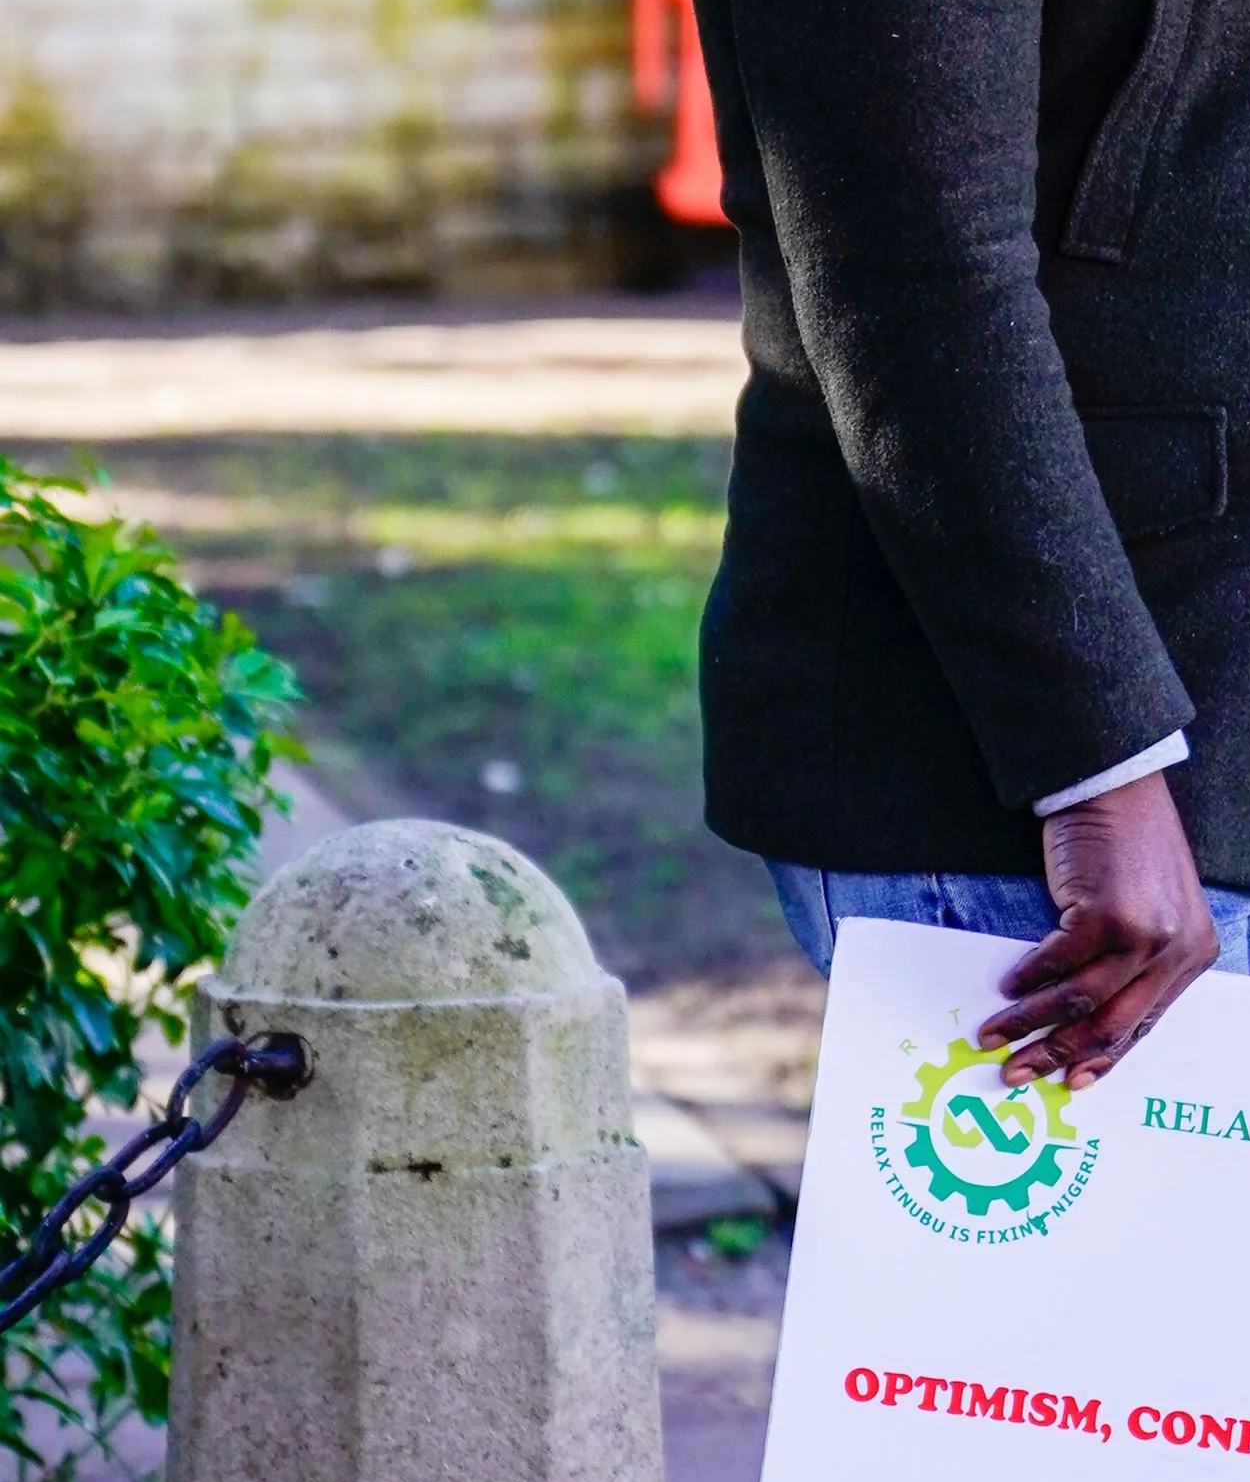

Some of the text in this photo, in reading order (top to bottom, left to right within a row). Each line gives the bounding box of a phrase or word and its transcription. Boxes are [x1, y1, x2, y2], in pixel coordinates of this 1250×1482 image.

[899, 1007, 961, 1057] R T
[870, 1106, 892, 1172] RELAX
[885, 1172, 947, 1234] TINUBU
[948, 1224, 972, 1243] IS
[1050, 1137, 1101, 1218] NIGERIA
[844, 1367, 1112, 1443] OPTIMISM,
